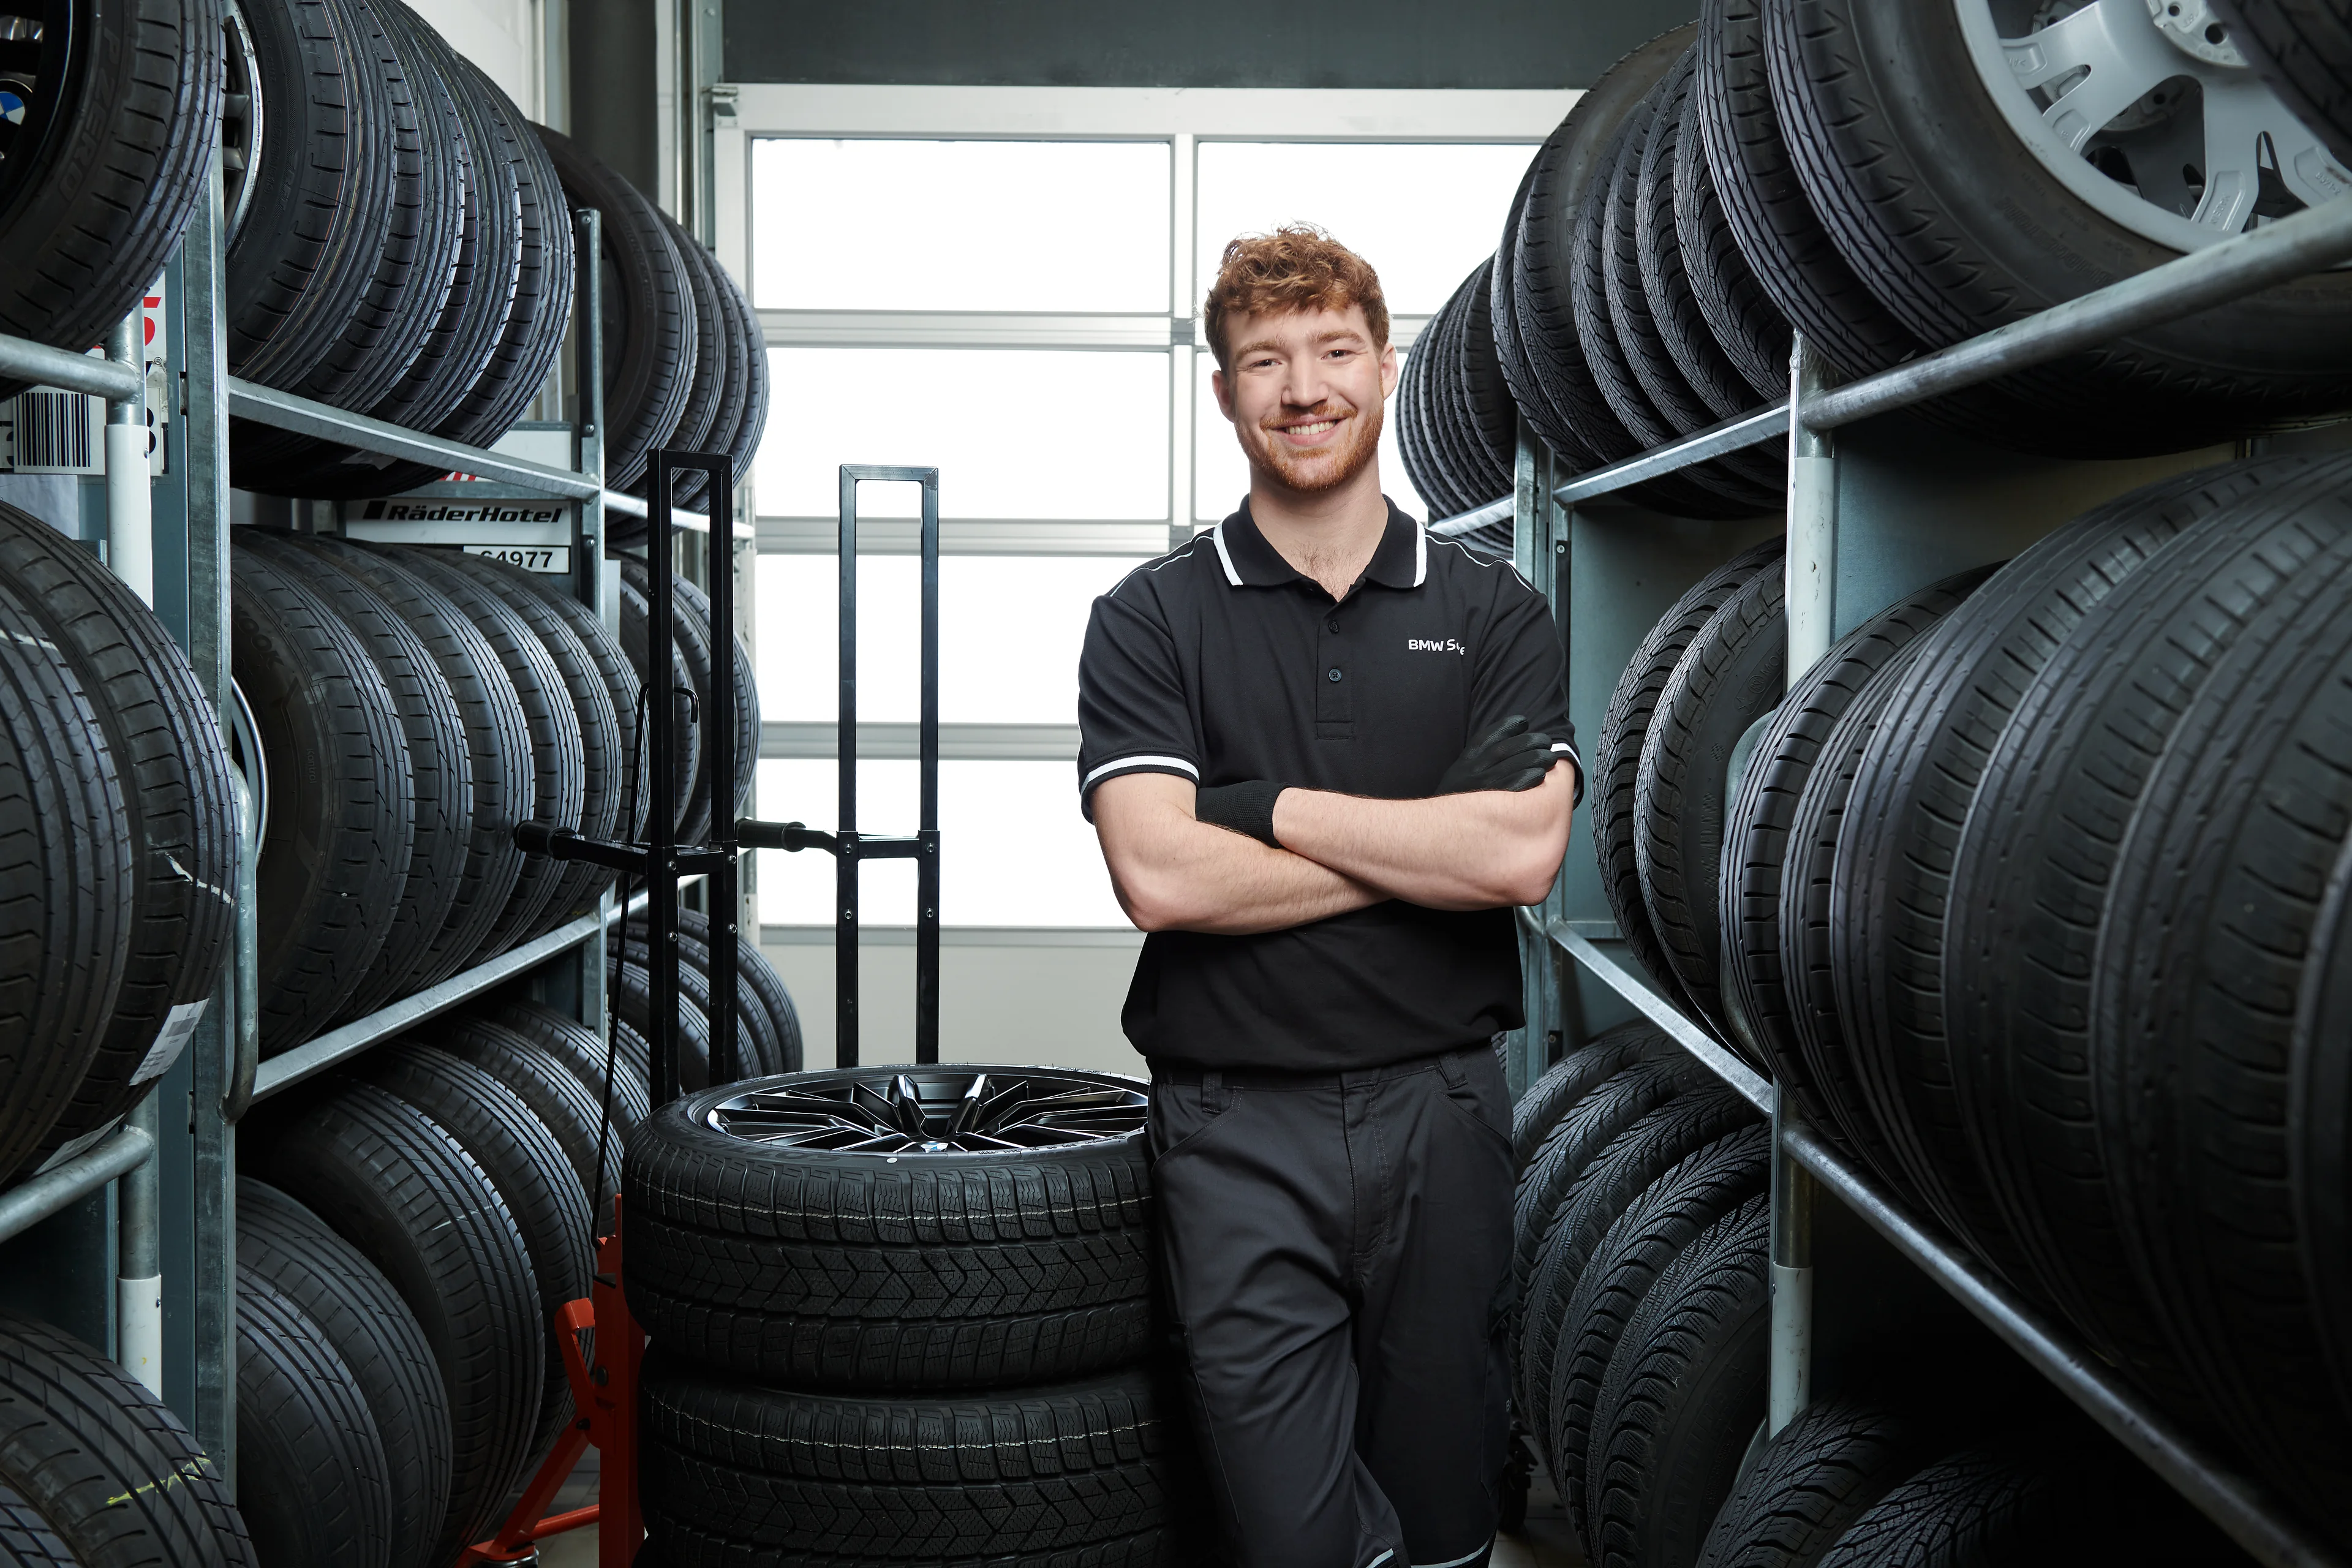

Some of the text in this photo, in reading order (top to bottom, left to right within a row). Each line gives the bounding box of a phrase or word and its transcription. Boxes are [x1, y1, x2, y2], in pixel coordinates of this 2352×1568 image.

[386, 505, 563, 523] RäderHotel
[1408, 639, 1444, 652] BMW
[306, 747, 318, 785] Kontrol
